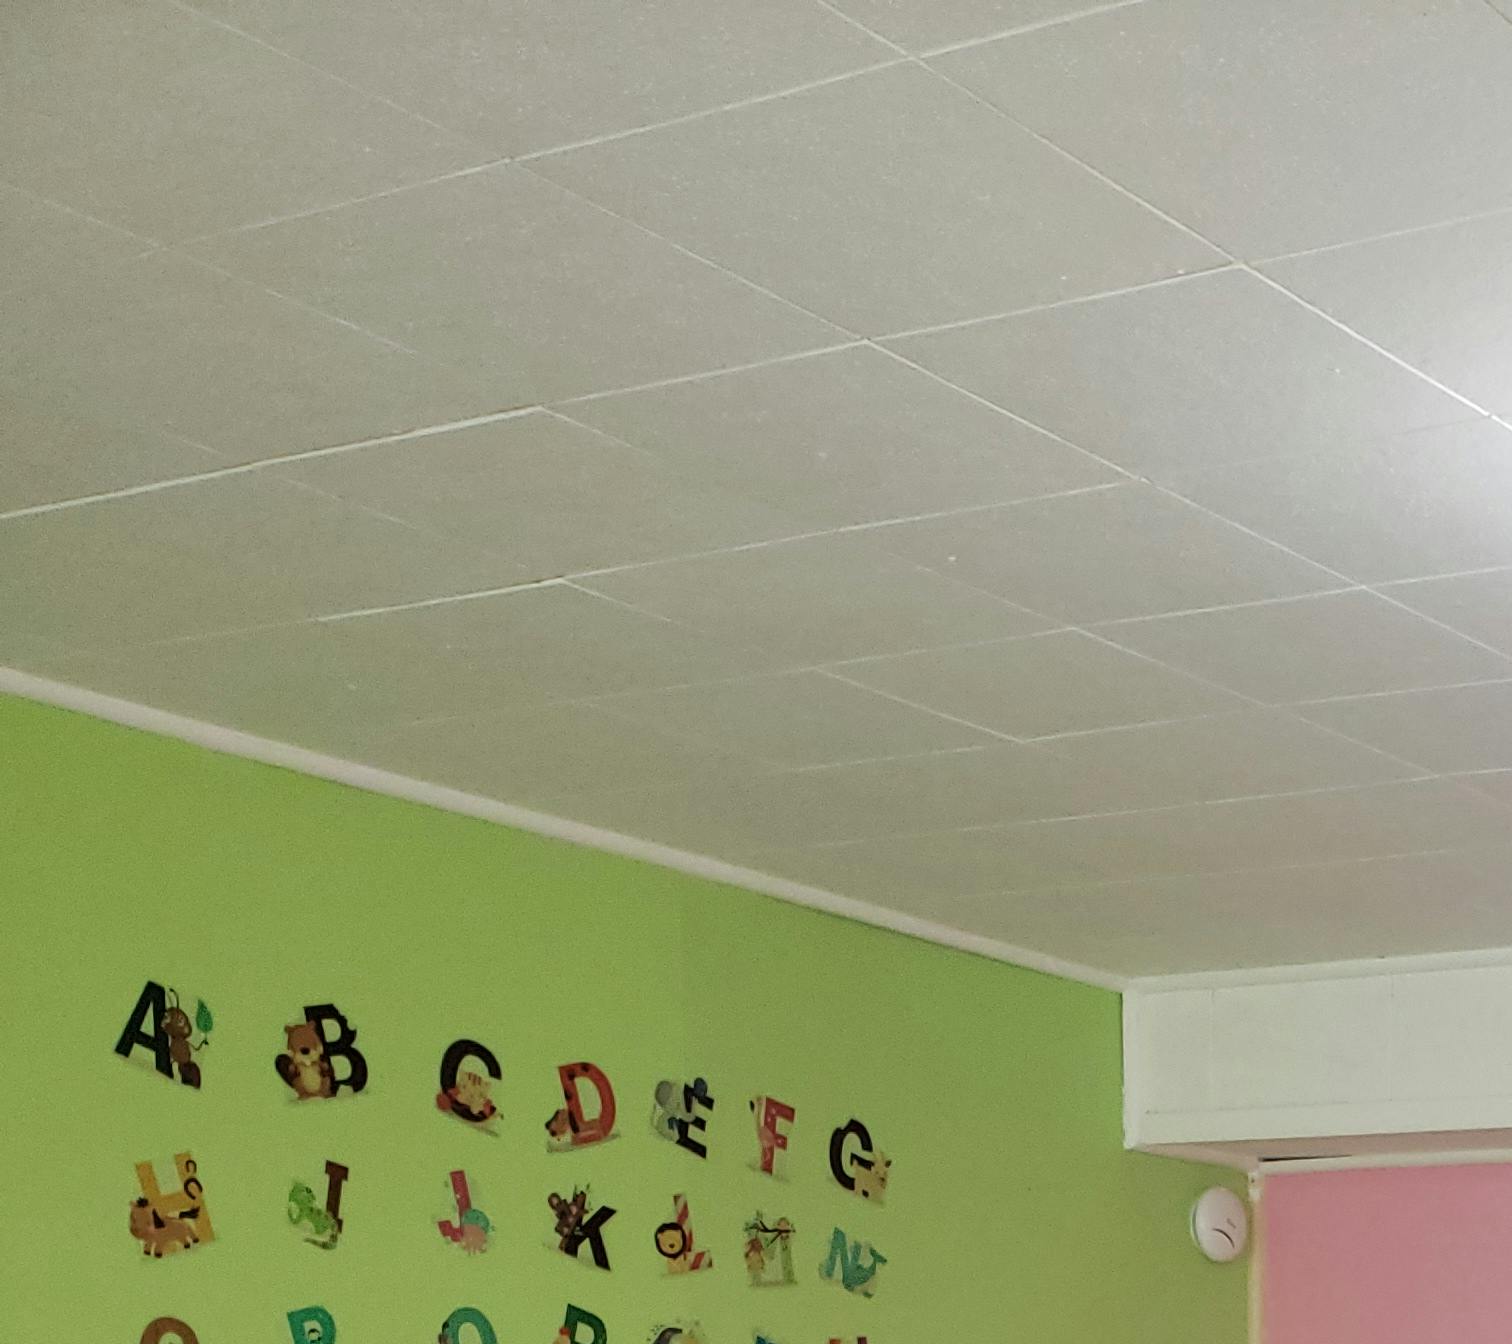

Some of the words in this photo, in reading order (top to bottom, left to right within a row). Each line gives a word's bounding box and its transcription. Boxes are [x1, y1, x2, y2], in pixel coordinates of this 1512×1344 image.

[114, 980, 175, 1080] A
[303, 1003, 368, 1098] B
[440, 1039, 502, 1122] C
[558, 1062, 616, 1145] D
[675, 1081, 714, 1159] E
[757, 1096, 795, 1175] F
[829, 1118, 876, 1191] G
[135, 1152, 215, 1250] H
[438, 1170, 472, 1243] J
[552, 1195, 616, 1271] K
[671, 1194, 713, 1272] L
[820, 1227, 877, 1291] N
